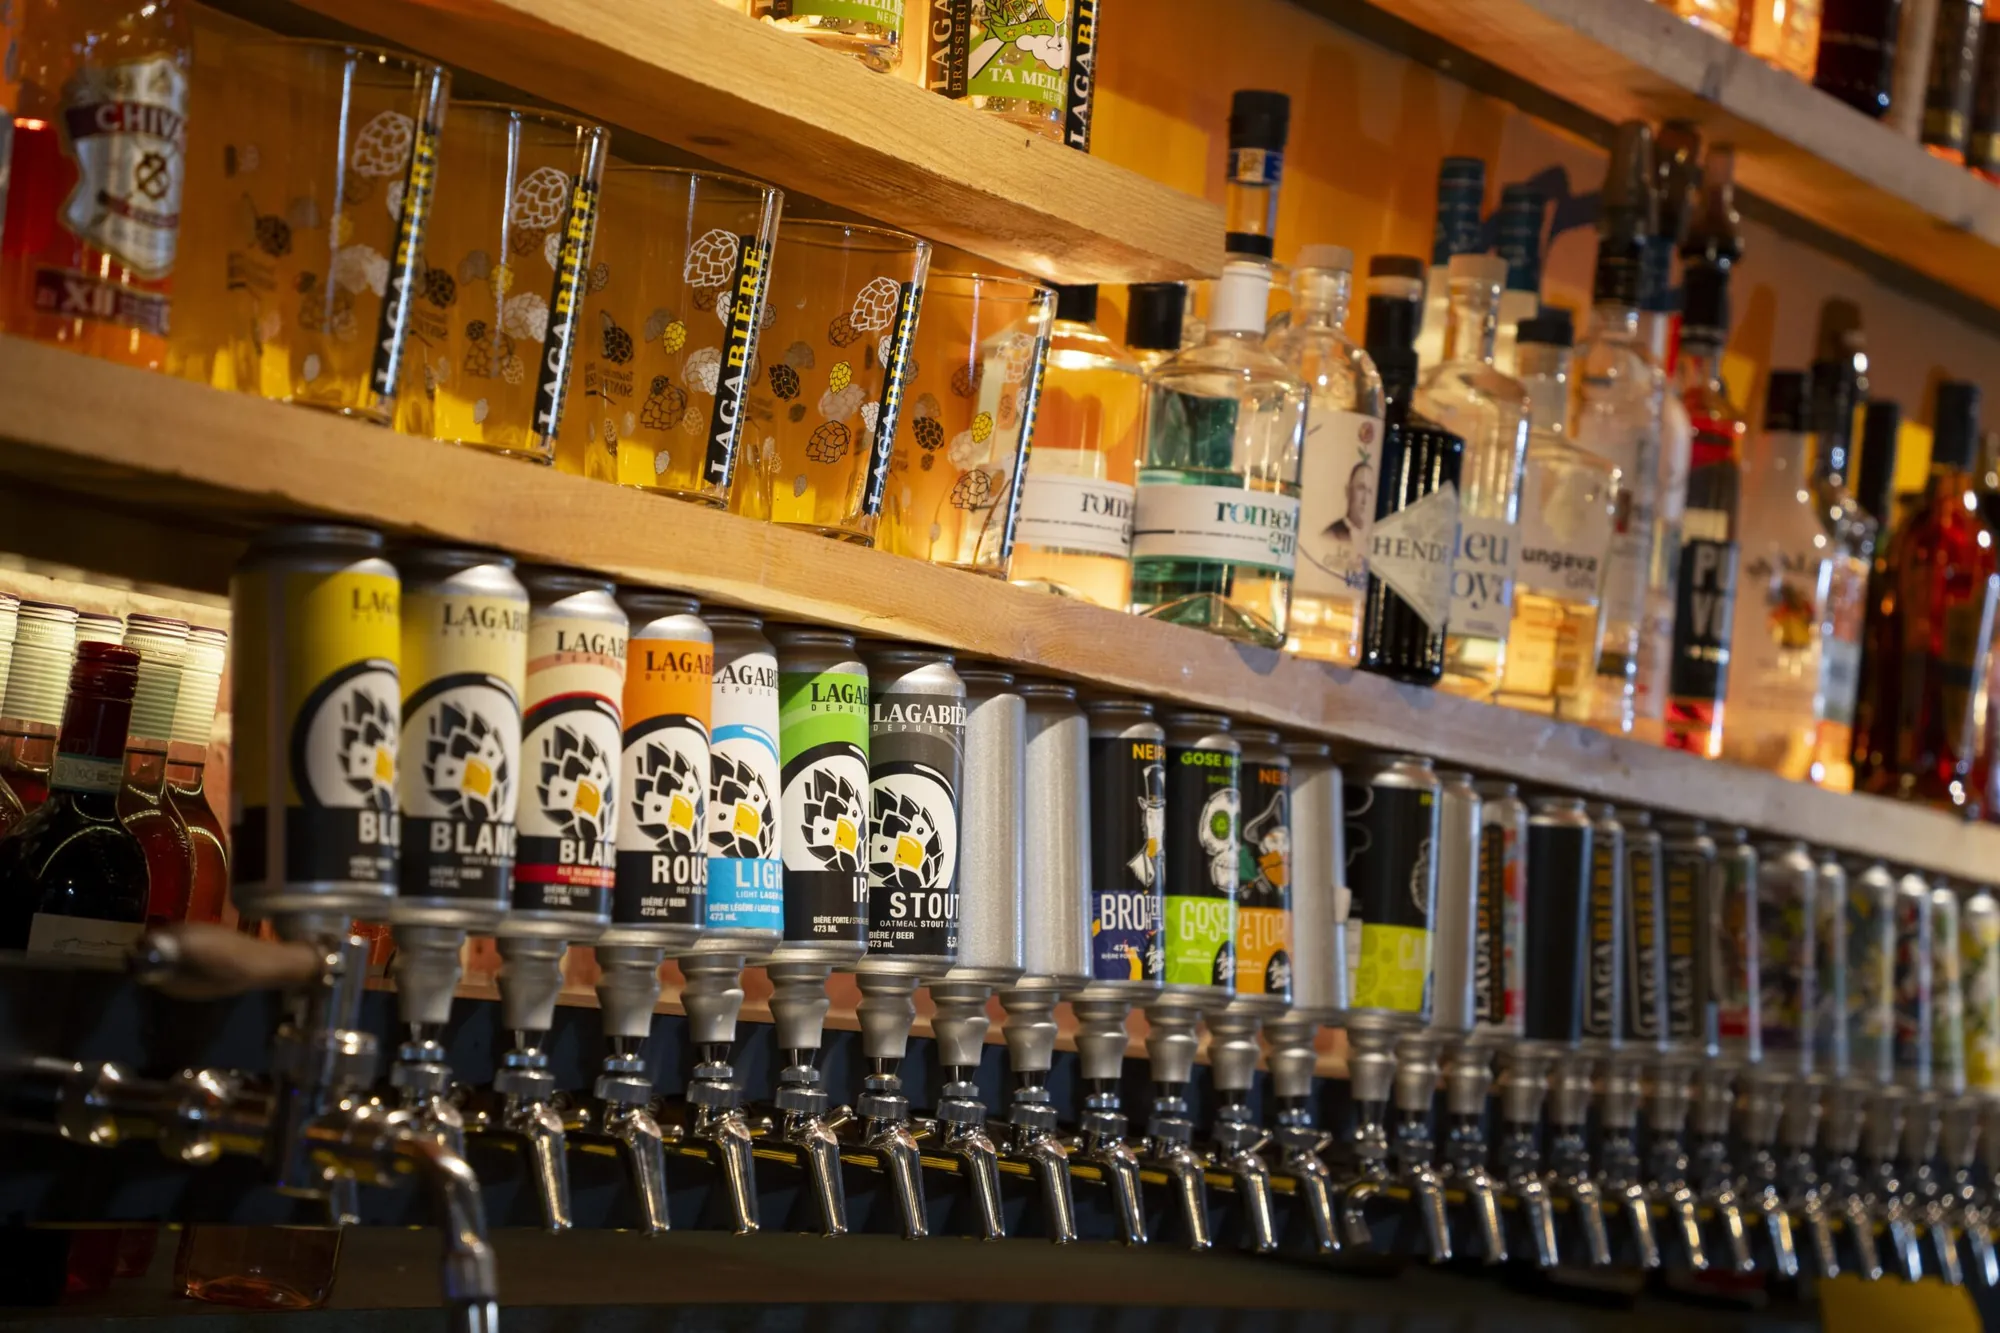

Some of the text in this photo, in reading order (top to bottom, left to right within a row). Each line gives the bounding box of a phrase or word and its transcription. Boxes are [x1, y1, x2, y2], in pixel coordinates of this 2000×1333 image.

[989, 67, 1015, 84] TA
[1521, 546, 1599, 573] ungava
[873, 723, 944, 734] DEPUIS
[1180, 751, 1221, 768] GOSE
[813, 915, 832, 925] BIÈRE
[880, 919, 918, 928] OATMEAL
[920, 920, 944, 928] STOUT
[813, 925, 827, 934] 473
[868, 930, 889, 940] BIÈRE
[895, 931, 915, 940] BEER
[868, 940, 882, 949] 473
